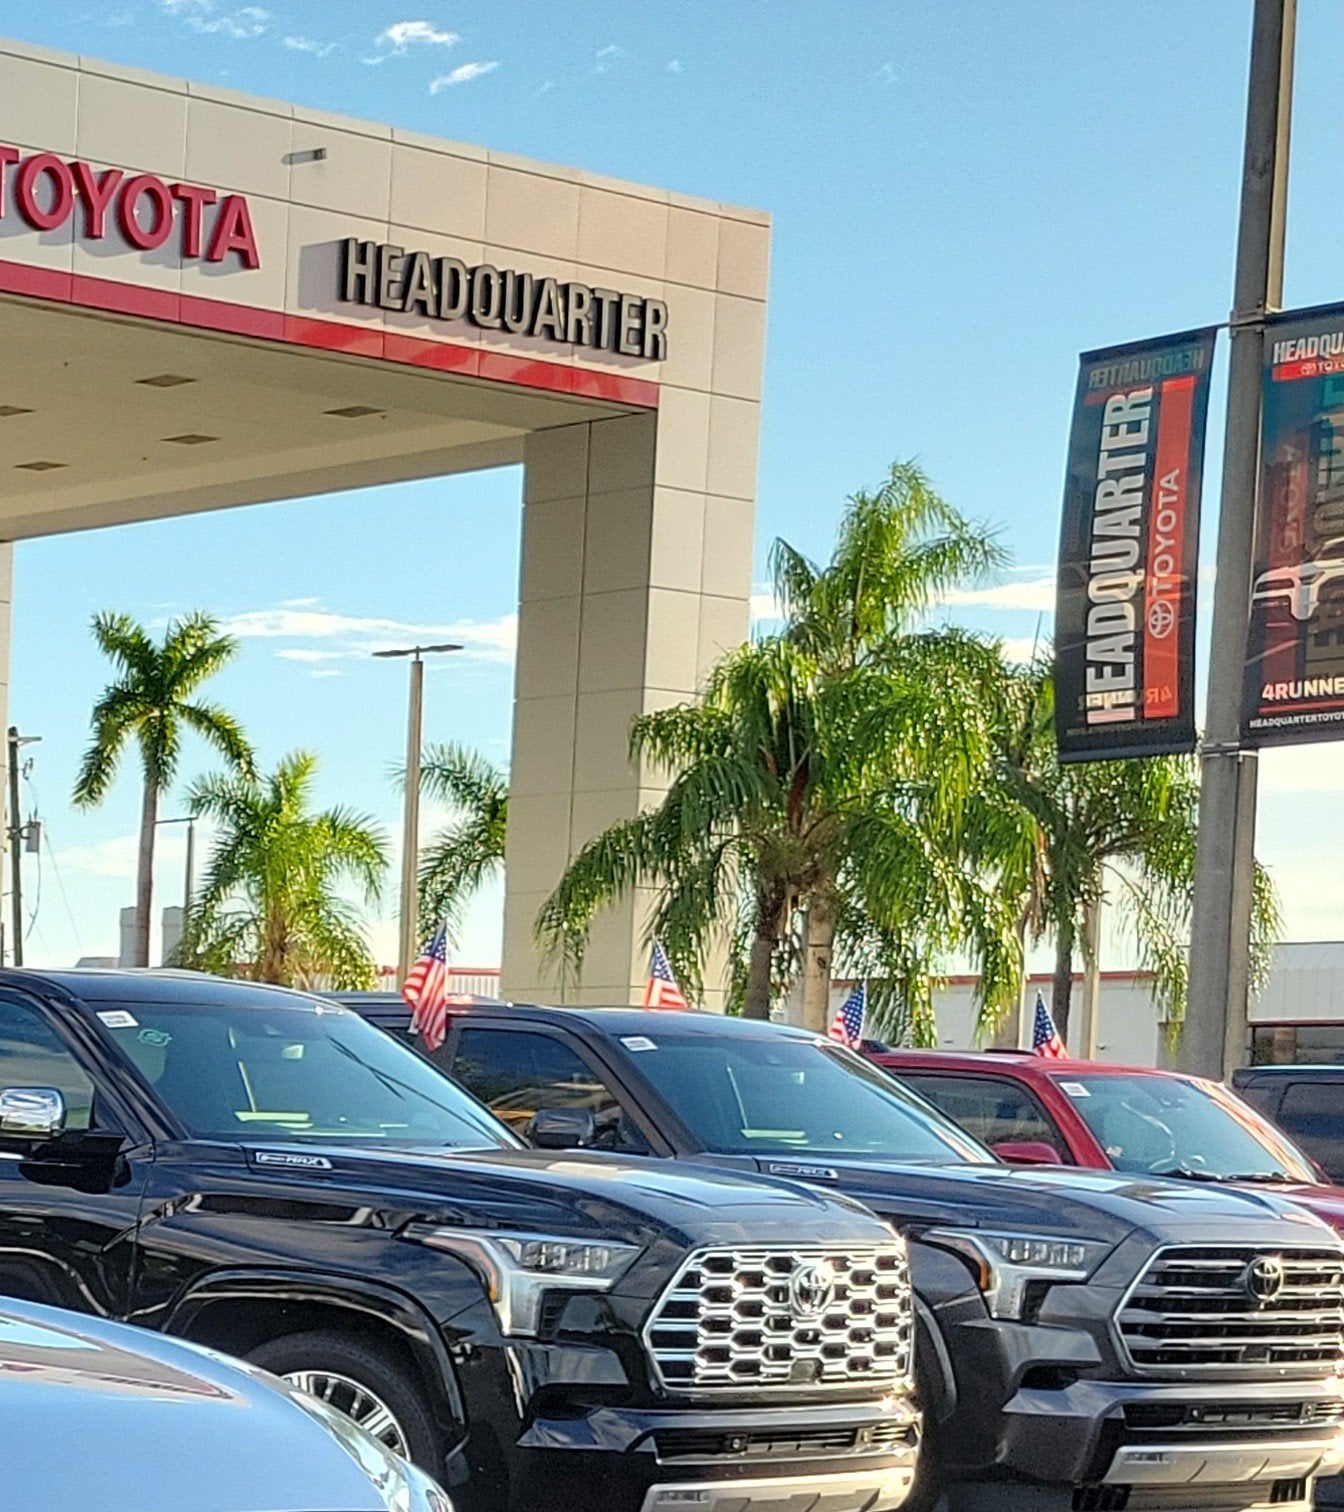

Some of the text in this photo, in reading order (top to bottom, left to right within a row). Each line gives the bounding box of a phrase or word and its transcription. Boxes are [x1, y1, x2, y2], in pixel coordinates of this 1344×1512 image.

[340, 238, 669, 360] HEADQUARTER
[1273, 331, 1344, 364] HEADQU
[1086, 386, 1154, 724] HEADQUARTER
[1150, 469, 1180, 596] TOYOTA
